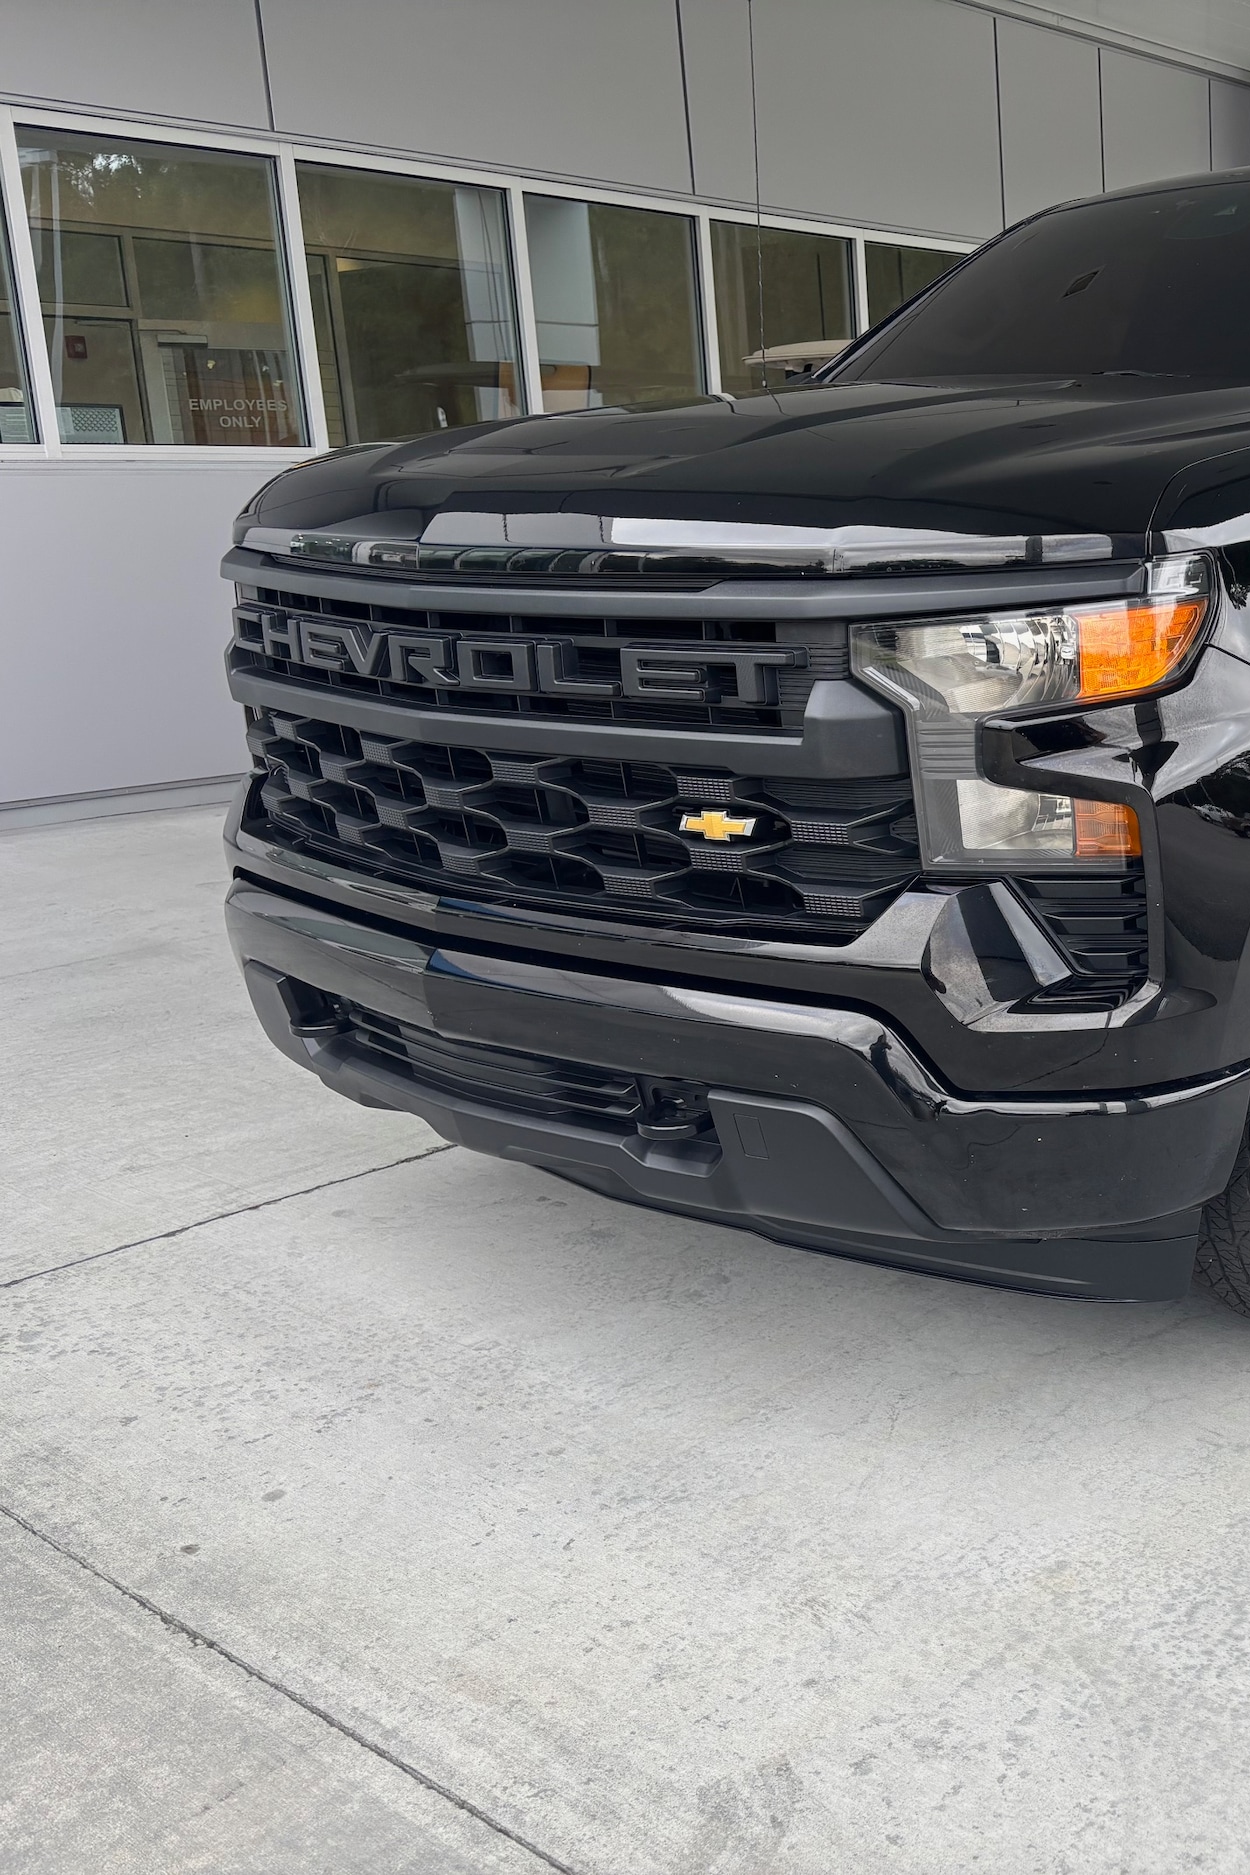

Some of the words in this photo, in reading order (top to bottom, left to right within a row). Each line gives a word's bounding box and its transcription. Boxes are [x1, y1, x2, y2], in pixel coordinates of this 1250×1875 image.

[189, 398, 288, 412] EMPLOYEES
[219, 416, 262, 428] ONLY
[234, 602, 809, 706] CHEVROLET
